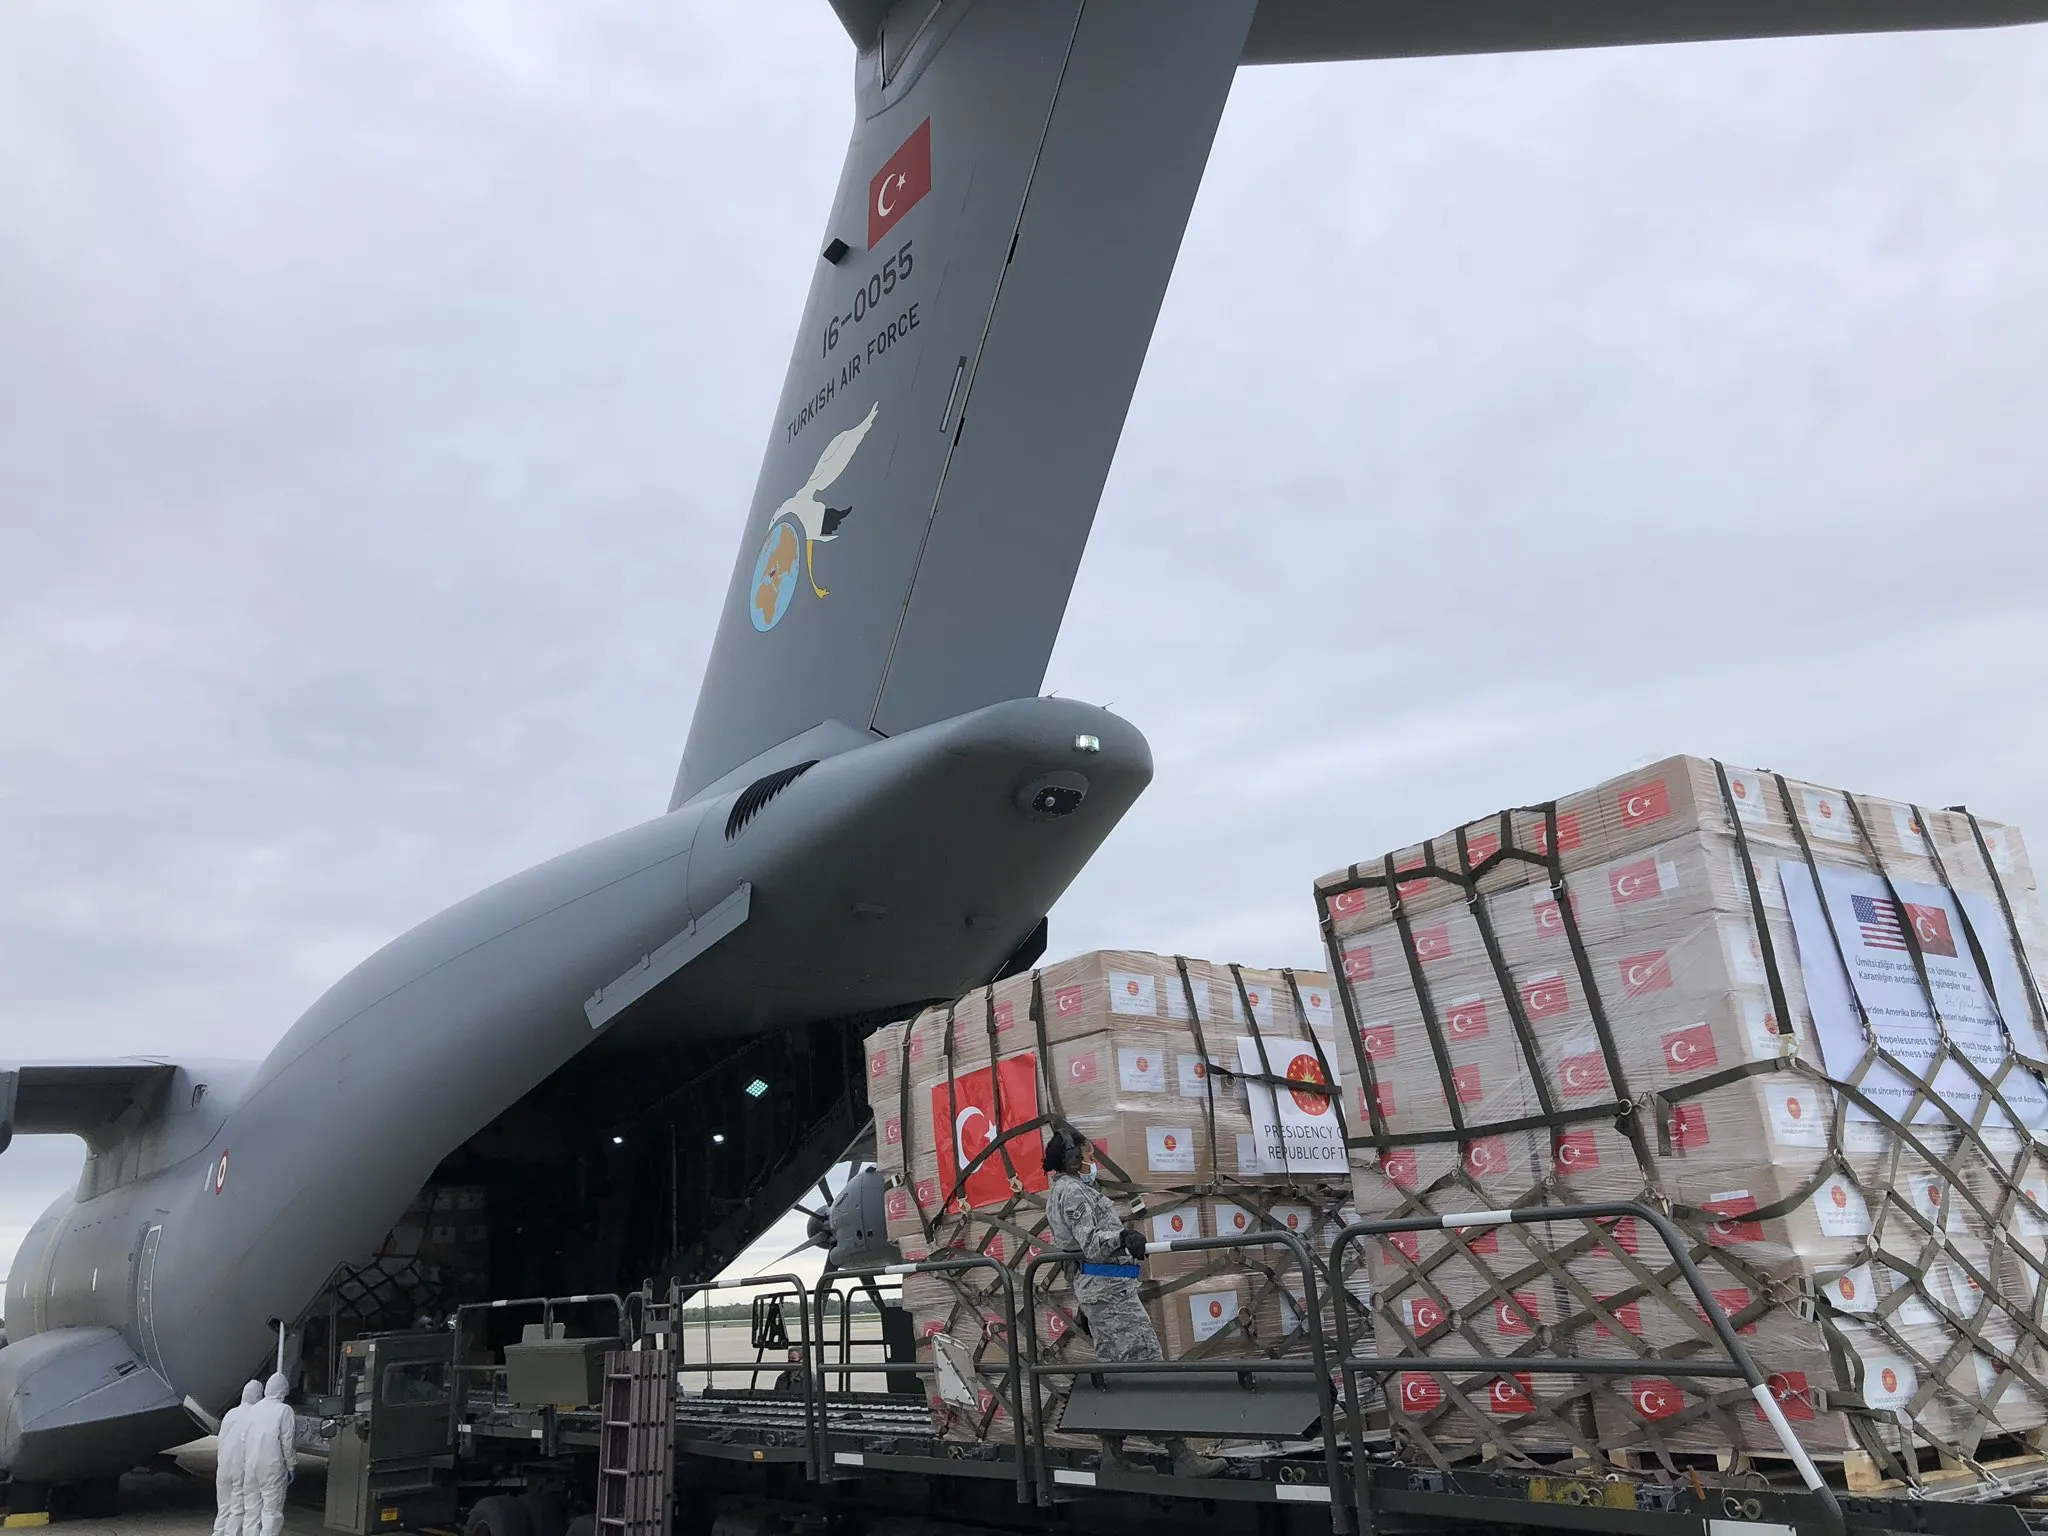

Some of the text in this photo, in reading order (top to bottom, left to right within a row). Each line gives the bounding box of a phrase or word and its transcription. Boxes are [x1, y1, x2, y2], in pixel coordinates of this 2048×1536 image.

[822, 239, 913, 359] 16-0055
[787, 302, 921, 443] TURKISH AIR FORCE
[1879, 1034, 1928, 1046] hopelessness
[1265, 1124, 1333, 1139] PRESIDENCY
[1268, 1145, 1320, 1160] REPUBLIC
[1322, 1146, 1336, 1160] OF
